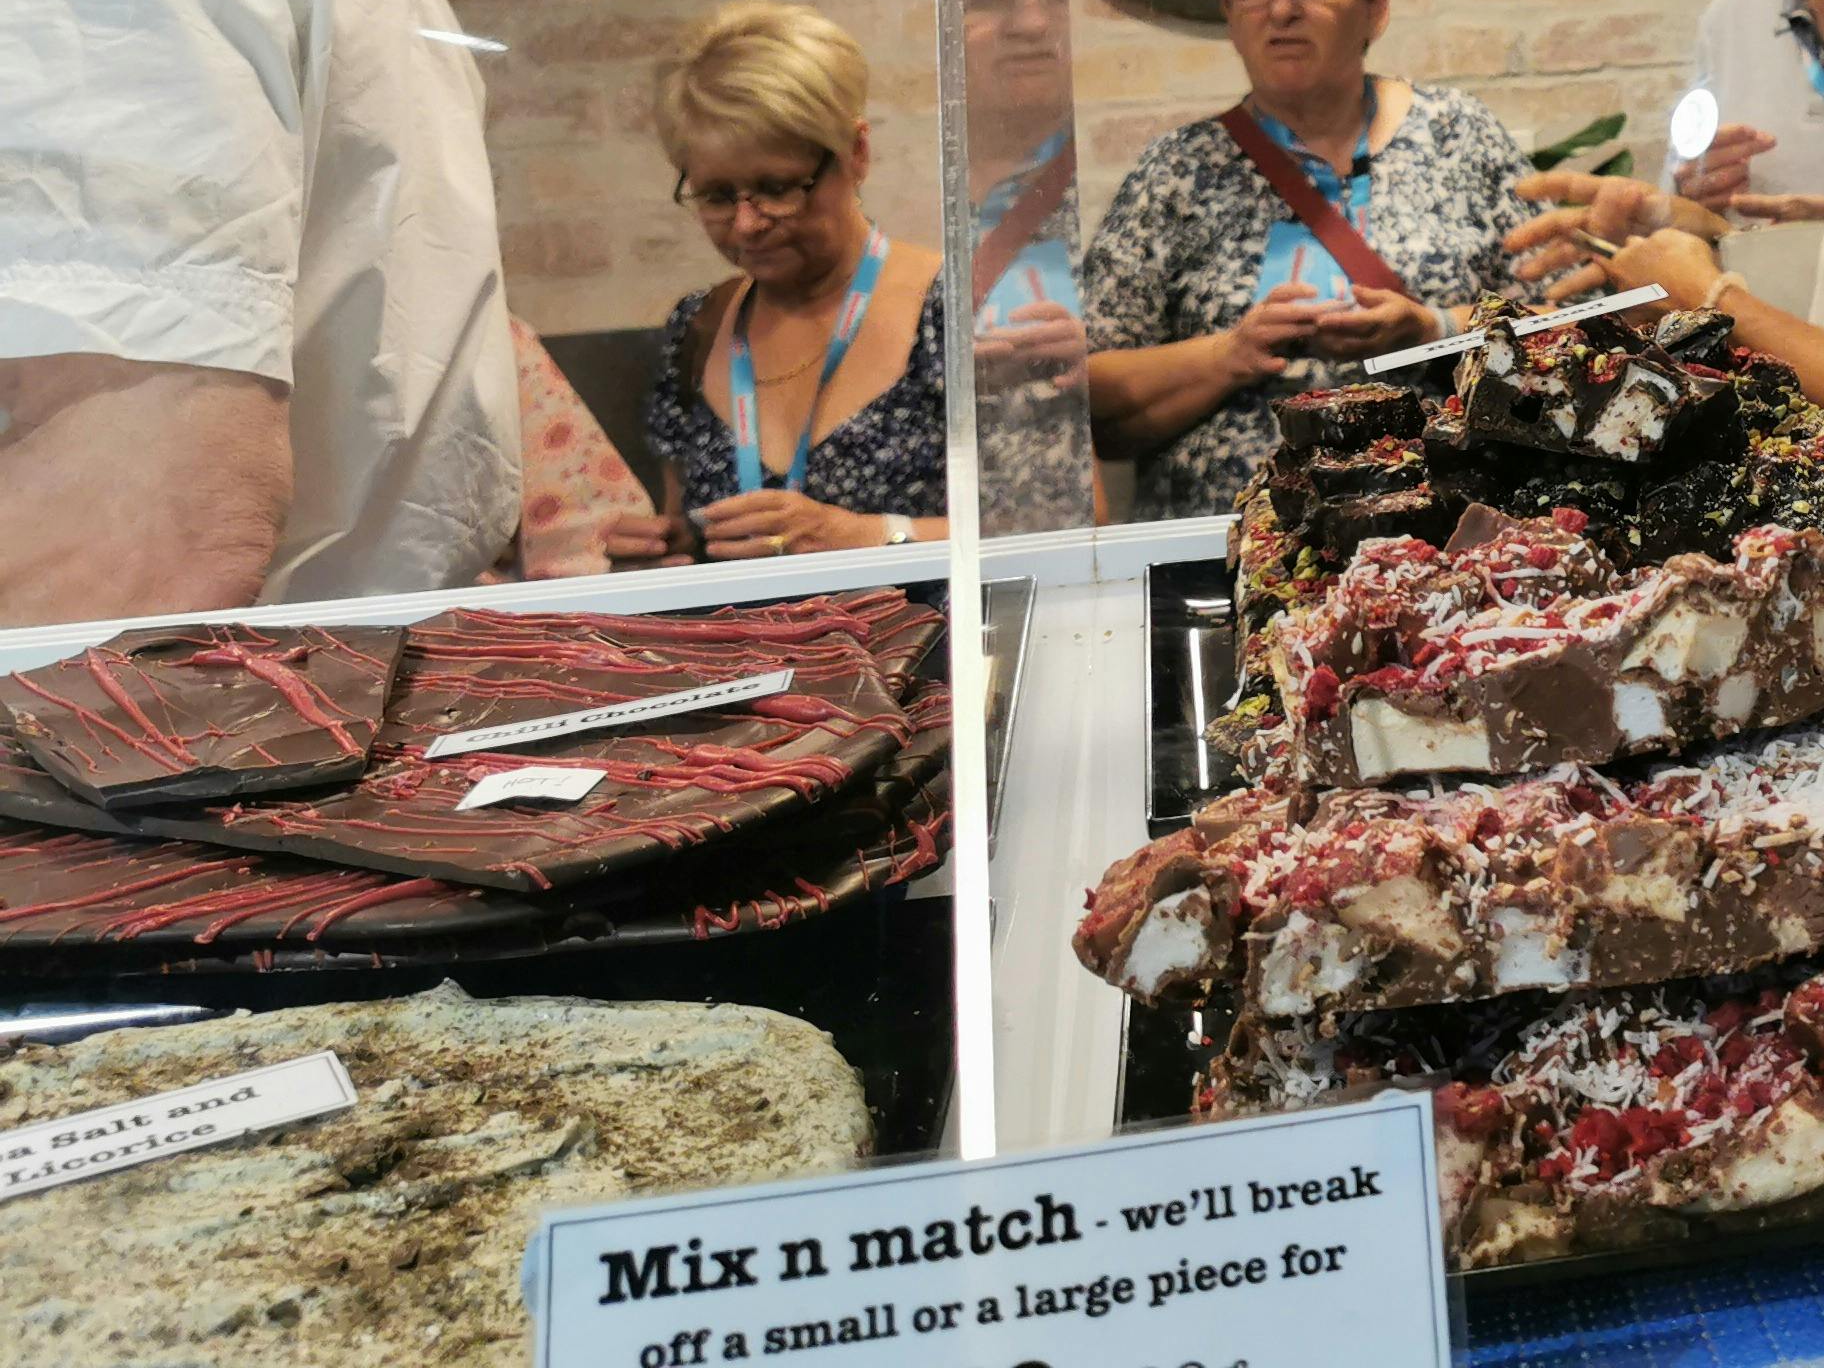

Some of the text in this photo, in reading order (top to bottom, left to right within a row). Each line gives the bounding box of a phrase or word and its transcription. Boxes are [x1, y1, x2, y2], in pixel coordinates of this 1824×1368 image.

[1530, 301, 1607, 325] Road
[580, 682, 762, 724] Chocolate
[50, 1114, 152, 1149] Salt
[167, 1086, 260, 1120] and
[5, 1122, 217, 1185] Licorice
[599, 1237, 758, 1306] Mix
[779, 1234, 828, 1282] n
[849, 1193, 1085, 1274] match
[1121, 1185, 1237, 1234] we'll
[1249, 1165, 1383, 1217] break
[638, 1243, 1348, 1368] off a small or a large piece for
